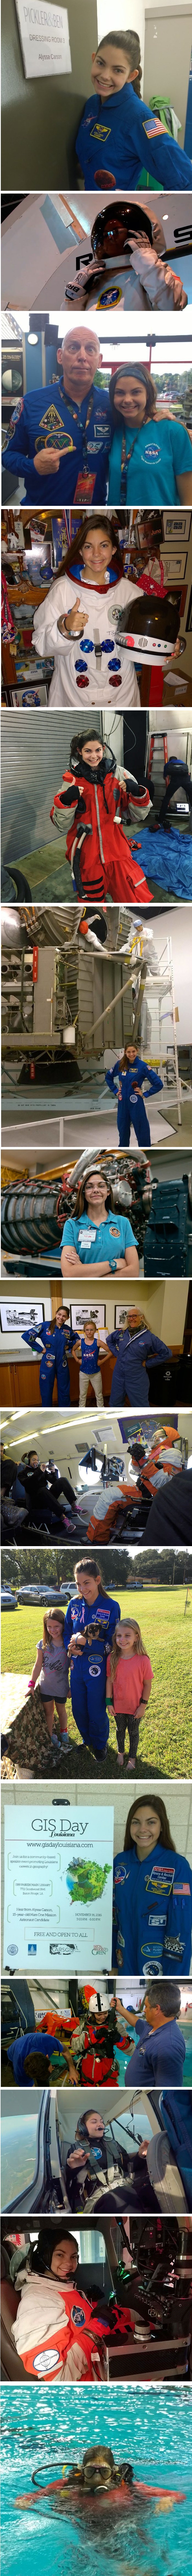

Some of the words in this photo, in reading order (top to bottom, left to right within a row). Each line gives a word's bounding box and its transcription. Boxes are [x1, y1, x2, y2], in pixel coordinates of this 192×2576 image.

[43, 1656, 63, 1671] Barbie
[31, 1819, 56, 1831] GIS
[60, 1819, 89, 1835] Day
